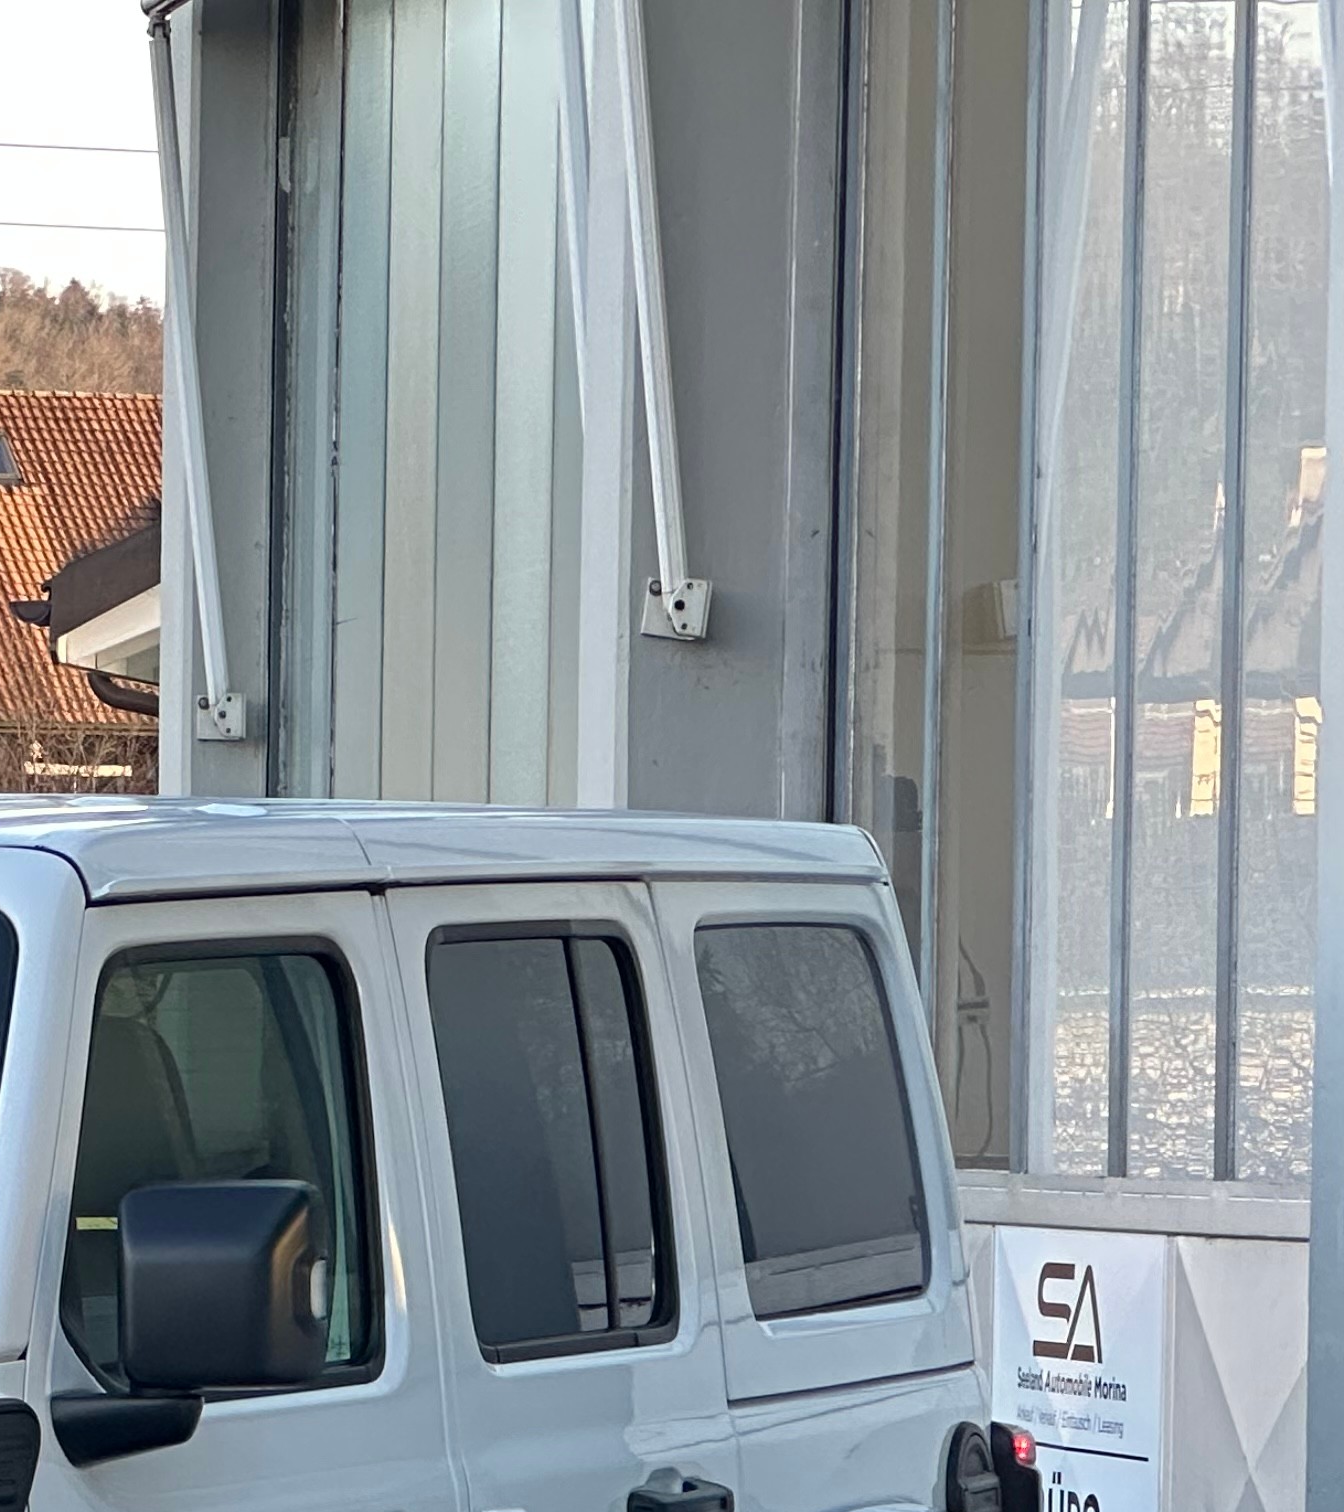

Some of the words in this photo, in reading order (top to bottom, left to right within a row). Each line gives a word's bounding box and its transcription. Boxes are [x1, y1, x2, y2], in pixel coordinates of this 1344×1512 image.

[1033, 1262, 1103, 1364] SA
[1017, 1366, 1044, 1391] Seeland
[1044, 1370, 1092, 1397] Automobile
[1094, 1376, 1127, 1402] Morina
